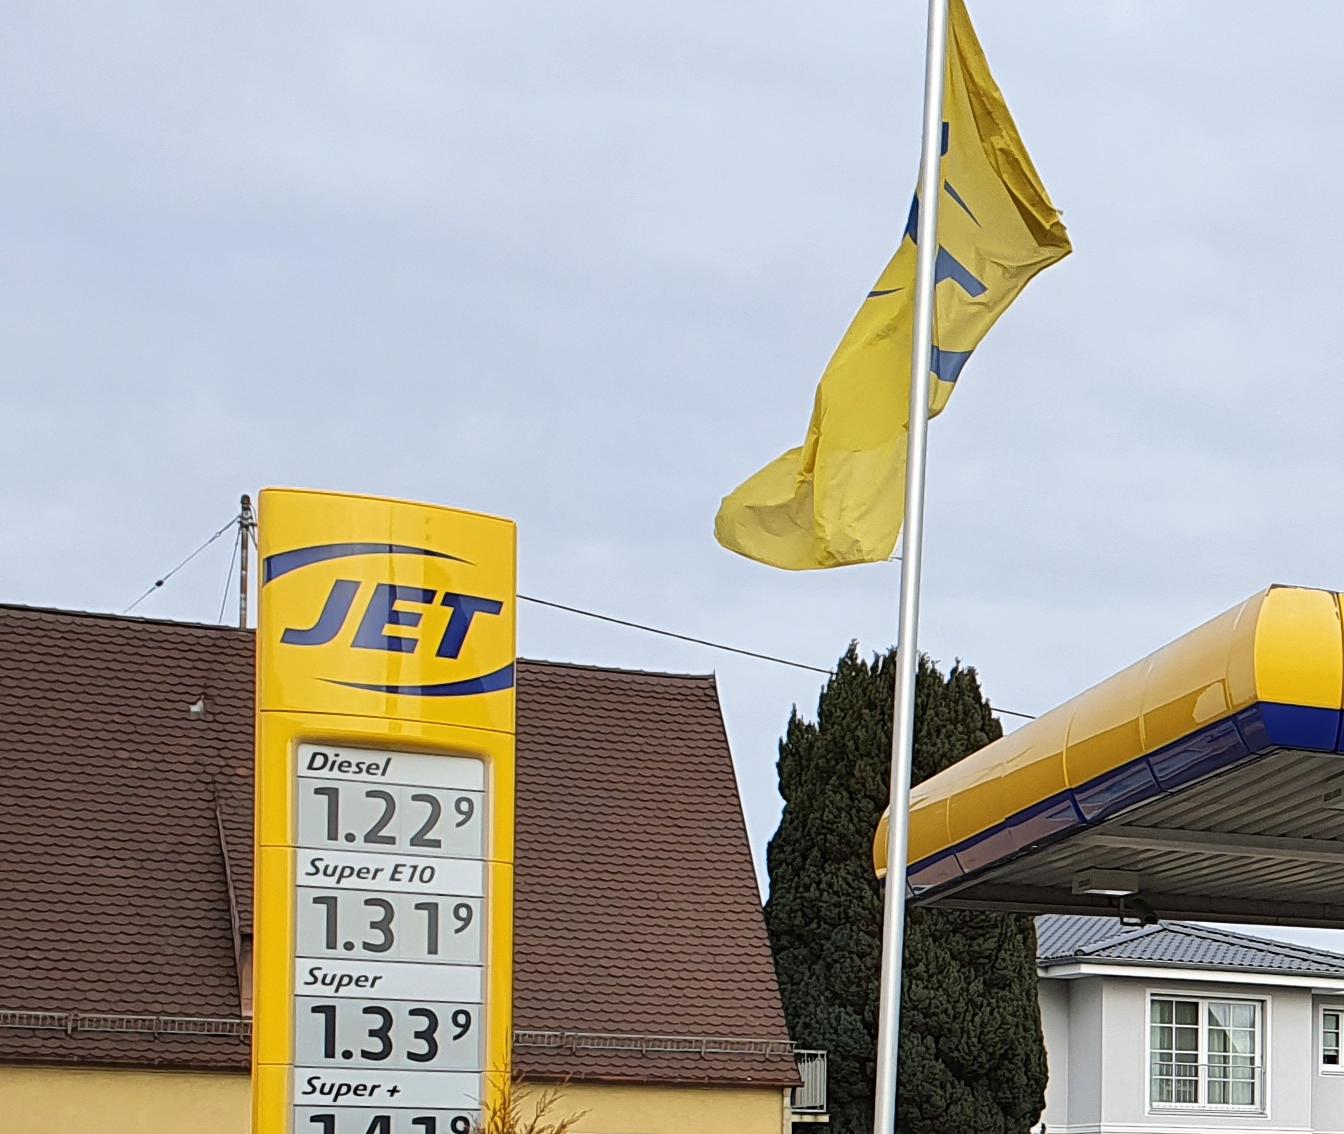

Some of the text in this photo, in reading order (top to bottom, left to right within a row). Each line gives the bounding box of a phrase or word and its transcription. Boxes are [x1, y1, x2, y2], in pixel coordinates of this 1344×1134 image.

[281, 580, 504, 660] JET
[306, 751, 392, 777] Diesel
[313, 787, 475, 848] 1.229
[305, 858, 435, 884] Super E10
[312, 896, 473, 955] 1.319
[304, 967, 382, 992] Super
[311, 1005, 472, 1062] 1.339
[302, 1076, 380, 1102] Super
